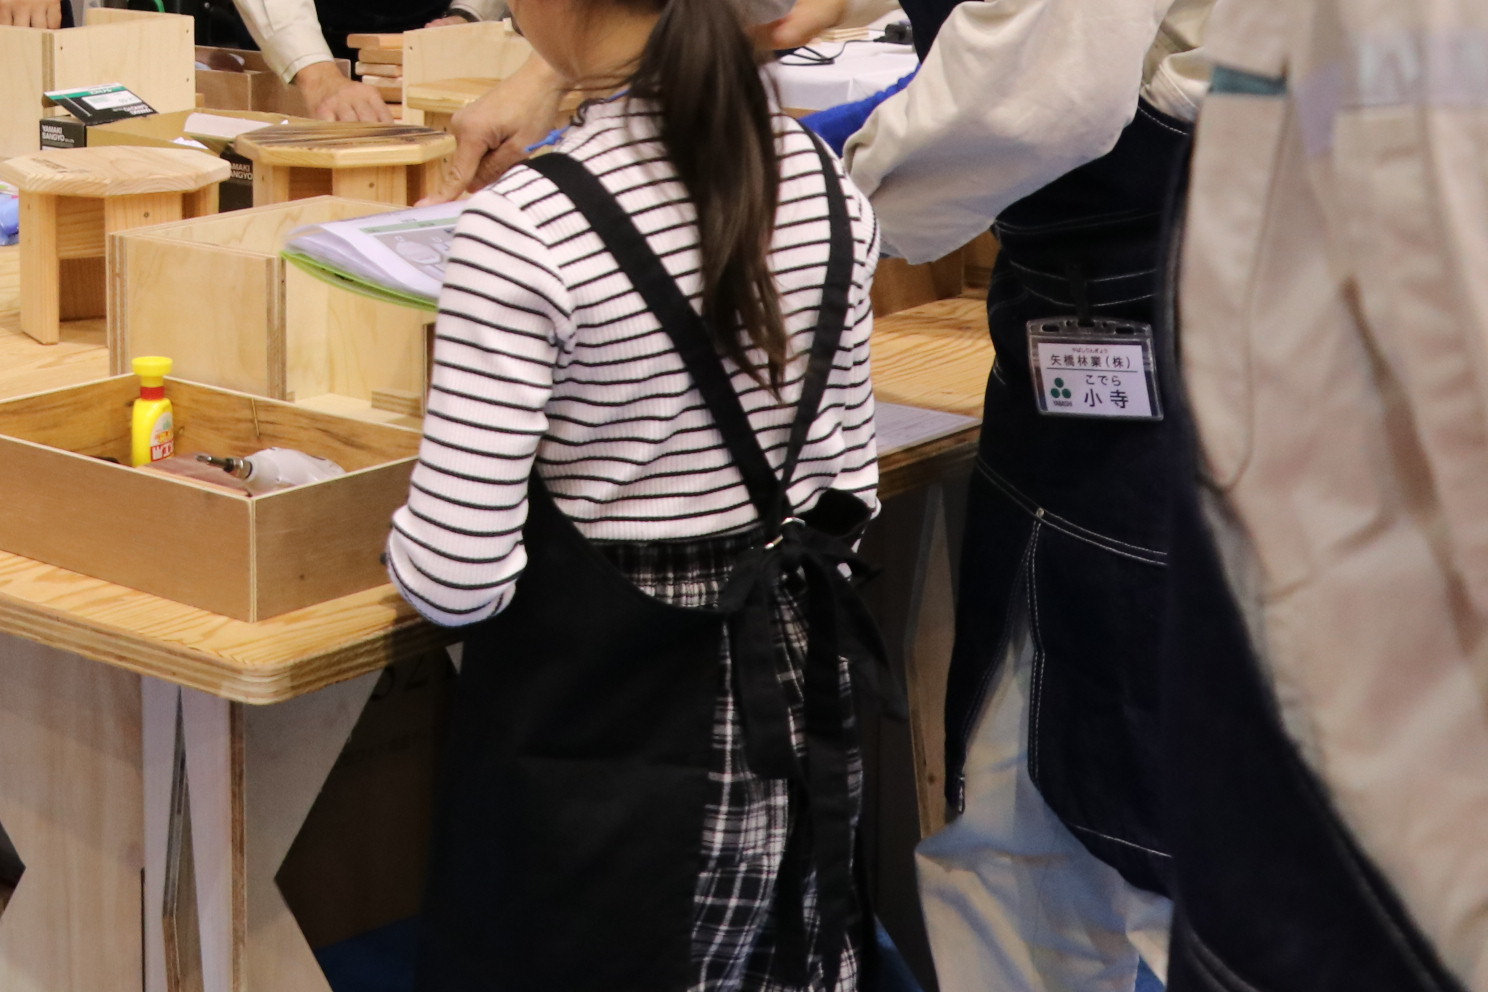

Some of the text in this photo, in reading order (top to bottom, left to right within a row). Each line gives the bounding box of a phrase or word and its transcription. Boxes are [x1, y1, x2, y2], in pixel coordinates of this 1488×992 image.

[42, 125, 63, 135] YAMAKI
[42, 132, 65, 142] SANGYO
[1086, 374, 1121, 386] こでら
[1084, 388, 1128, 408] 小寺
